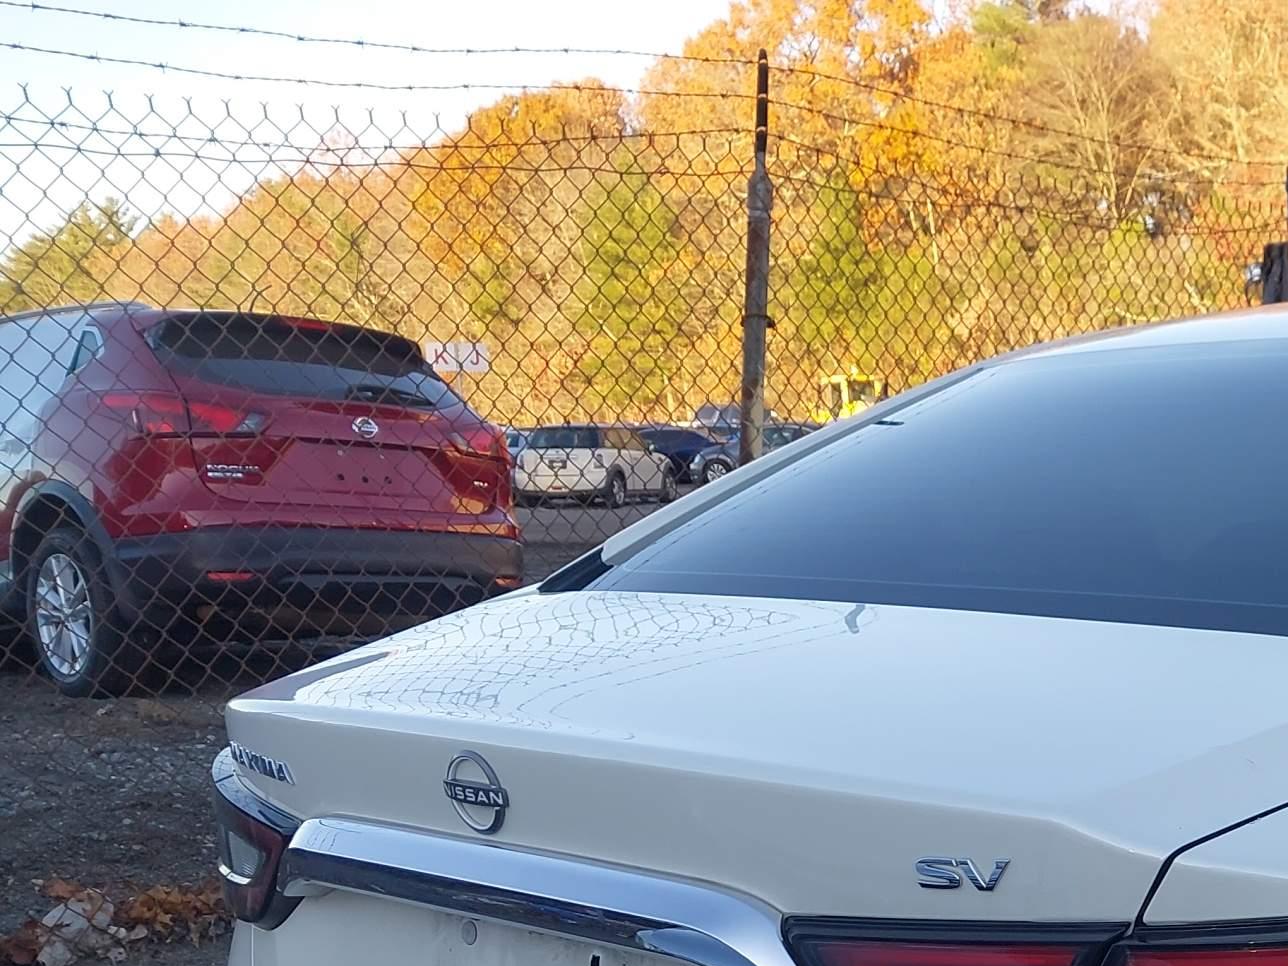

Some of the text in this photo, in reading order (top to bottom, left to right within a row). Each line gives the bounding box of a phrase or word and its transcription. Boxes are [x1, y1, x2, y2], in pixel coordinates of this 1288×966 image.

[434, 348, 449, 365] K
[470, 349, 480, 366] J
[443, 781, 504, 805] NISSAN
[914, 857, 1011, 892] SV
